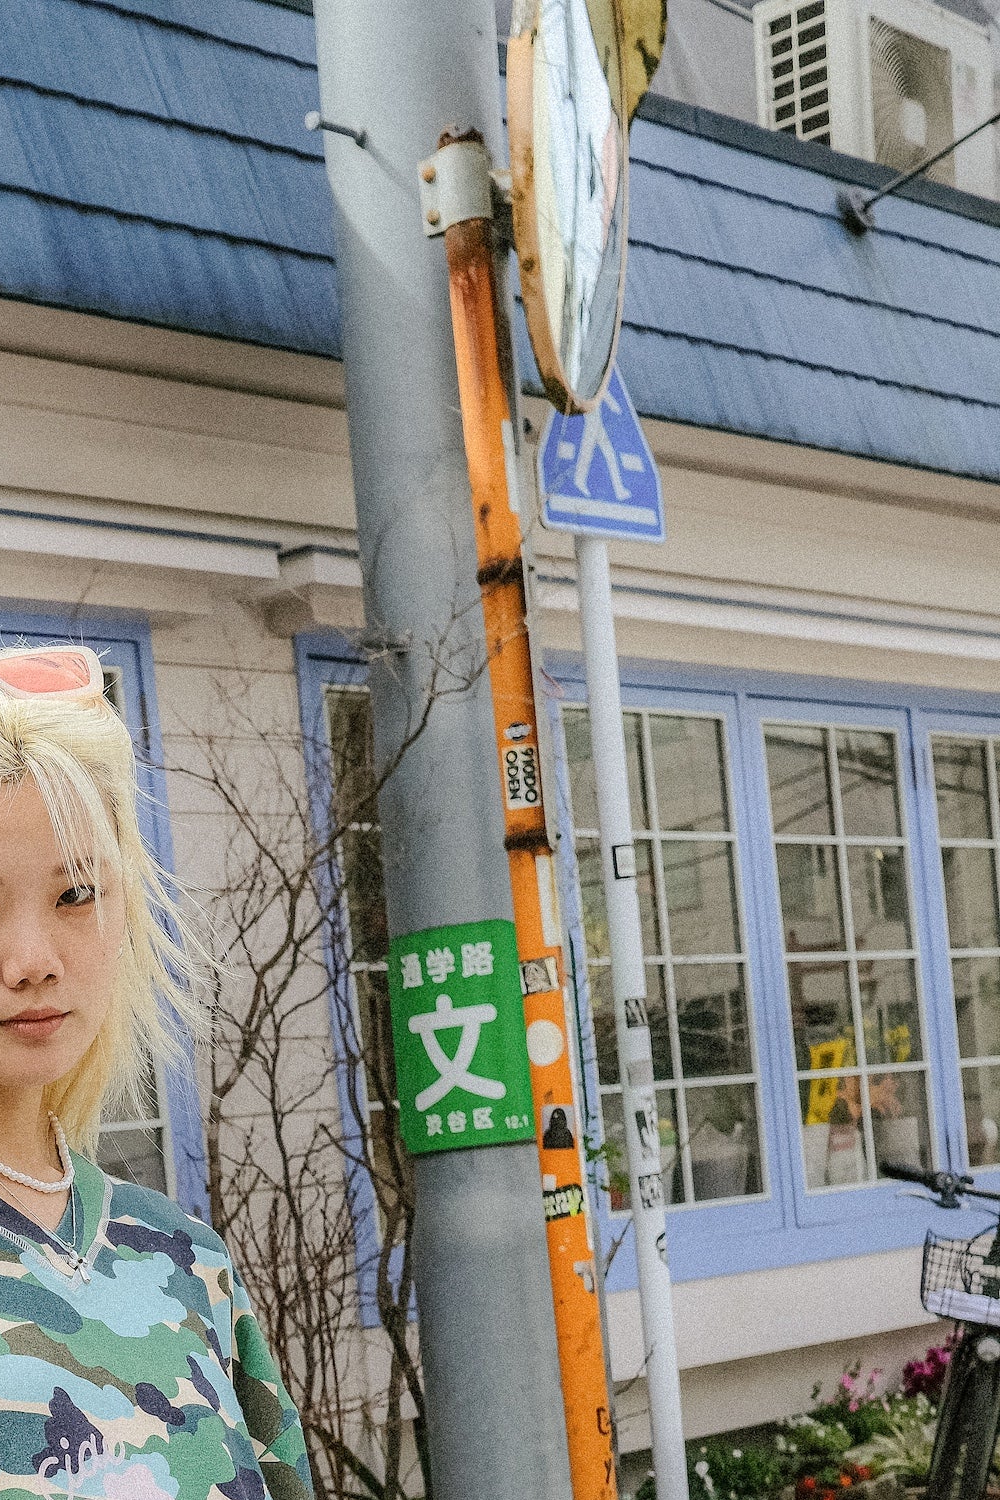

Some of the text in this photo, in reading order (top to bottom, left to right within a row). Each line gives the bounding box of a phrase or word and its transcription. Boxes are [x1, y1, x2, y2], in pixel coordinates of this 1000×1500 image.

[506, 750, 521, 800] ODEN
[401, 941, 494, 989] 通学路
[408, 994, 506, 1112] 文
